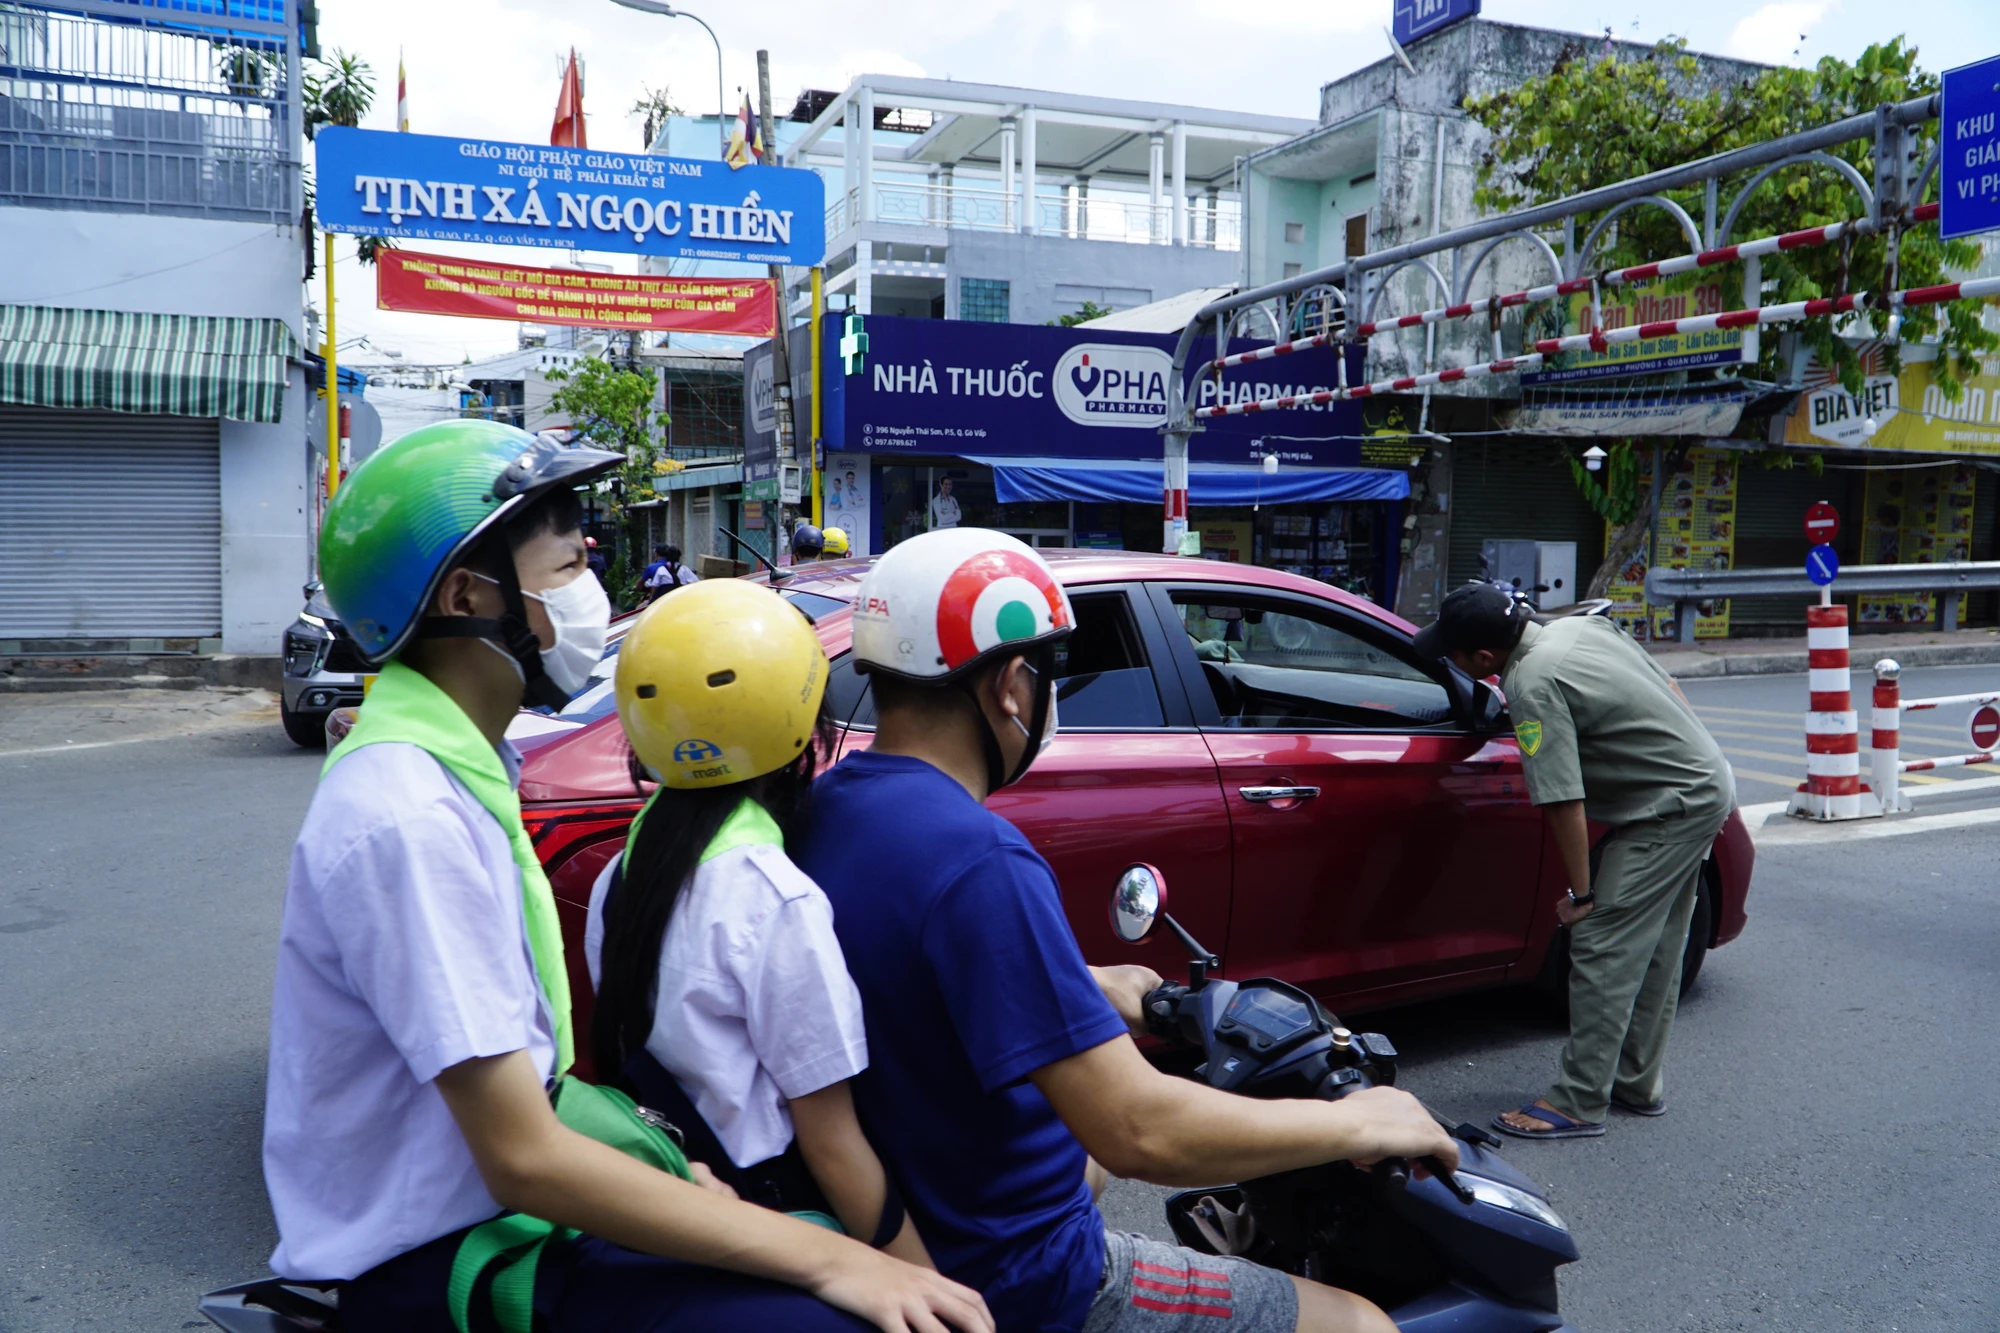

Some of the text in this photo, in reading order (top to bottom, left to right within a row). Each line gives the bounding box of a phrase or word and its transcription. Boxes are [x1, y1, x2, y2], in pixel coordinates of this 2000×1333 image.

[1956, 112, 1995, 141] KHU
[459, 142, 702, 177] GIÁO HỘI PHẬT GIÁO VIỆT NAM
[498, 164, 666, 189] NI GIỚI HỆ PHÁI KHẤT SĨ
[1957, 178, 1975, 199] VI
[354, 174, 794, 244] TỊNH XÁ NGỌC HIỀN
[416, 228, 430, 238] BÁ
[538, 238, 553, 247] TP.
[554, 239, 575, 248] HCM
[402, 260, 438, 274] KHÔNG
[439, 263, 465, 277] KINH
[466, 267, 502, 281] DOANH
[545, 274, 561, 286] GIA
[590, 277, 623, 291] KHÔNG
[641, 281, 660, 295] THỊT
[662, 282, 678, 295] GIA
[424, 278, 461, 293] KHÔNG
[552, 288, 584, 303] TRÁNH
[586, 292, 596, 305] BỊ
[598, 292, 616, 305] LÂY
[650, 296, 673, 310] DỊCH
[674, 297, 696, 311] CÚM
[697, 300, 714, 312] GIA
[517, 303, 537, 315] CHO
[539, 305, 556, 317] GIA
[557, 305, 581, 318] ĐÌNH
[583, 306, 596, 320] VÀ
[597, 308, 625, 323] CỘNG
[1703, 330, 1719, 347] Các
[1722, 329, 1740, 347] Loại
[873, 359, 1044, 399] NHÀ THUỐC
[1590, 366, 1605, 375] THÁI
[1089, 403, 1165, 414] PHARMACY
[1814, 381, 1893, 427] BIA VIỆT
[1922, 379, 1986, 425] QUÁN
[875, 438, 917, 447] 097.6789.621
[876, 426, 889, 434] 396
[890, 425, 915, 436] Nguyễn
[915, 427, 930, 436] Thái
[964, 428, 973, 437] Gò
[974, 428, 987, 438] Vấp
